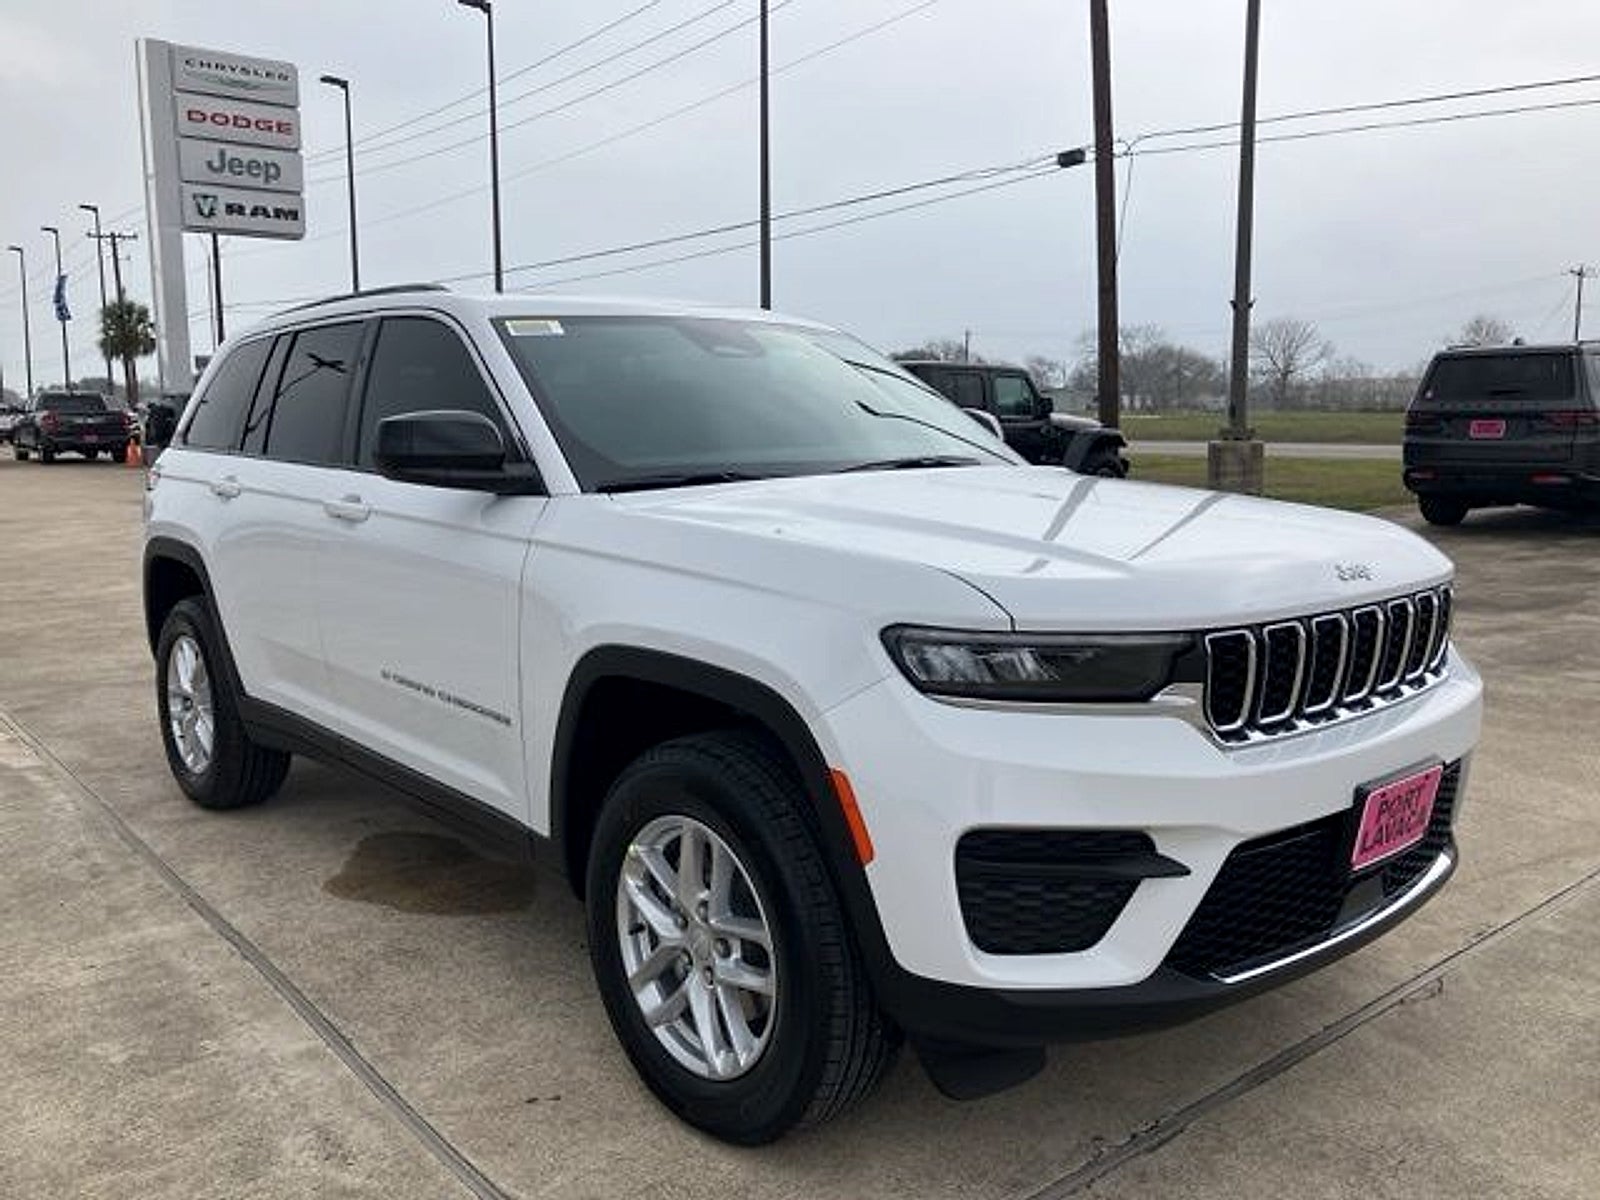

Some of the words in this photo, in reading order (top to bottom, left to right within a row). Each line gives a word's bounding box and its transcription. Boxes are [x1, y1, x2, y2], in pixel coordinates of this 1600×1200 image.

[184, 58, 289, 81] CHRYSLER
[187, 110, 294, 134] DODGE
[206, 149, 282, 183] Jeep
[224, 202, 299, 221] RAM
